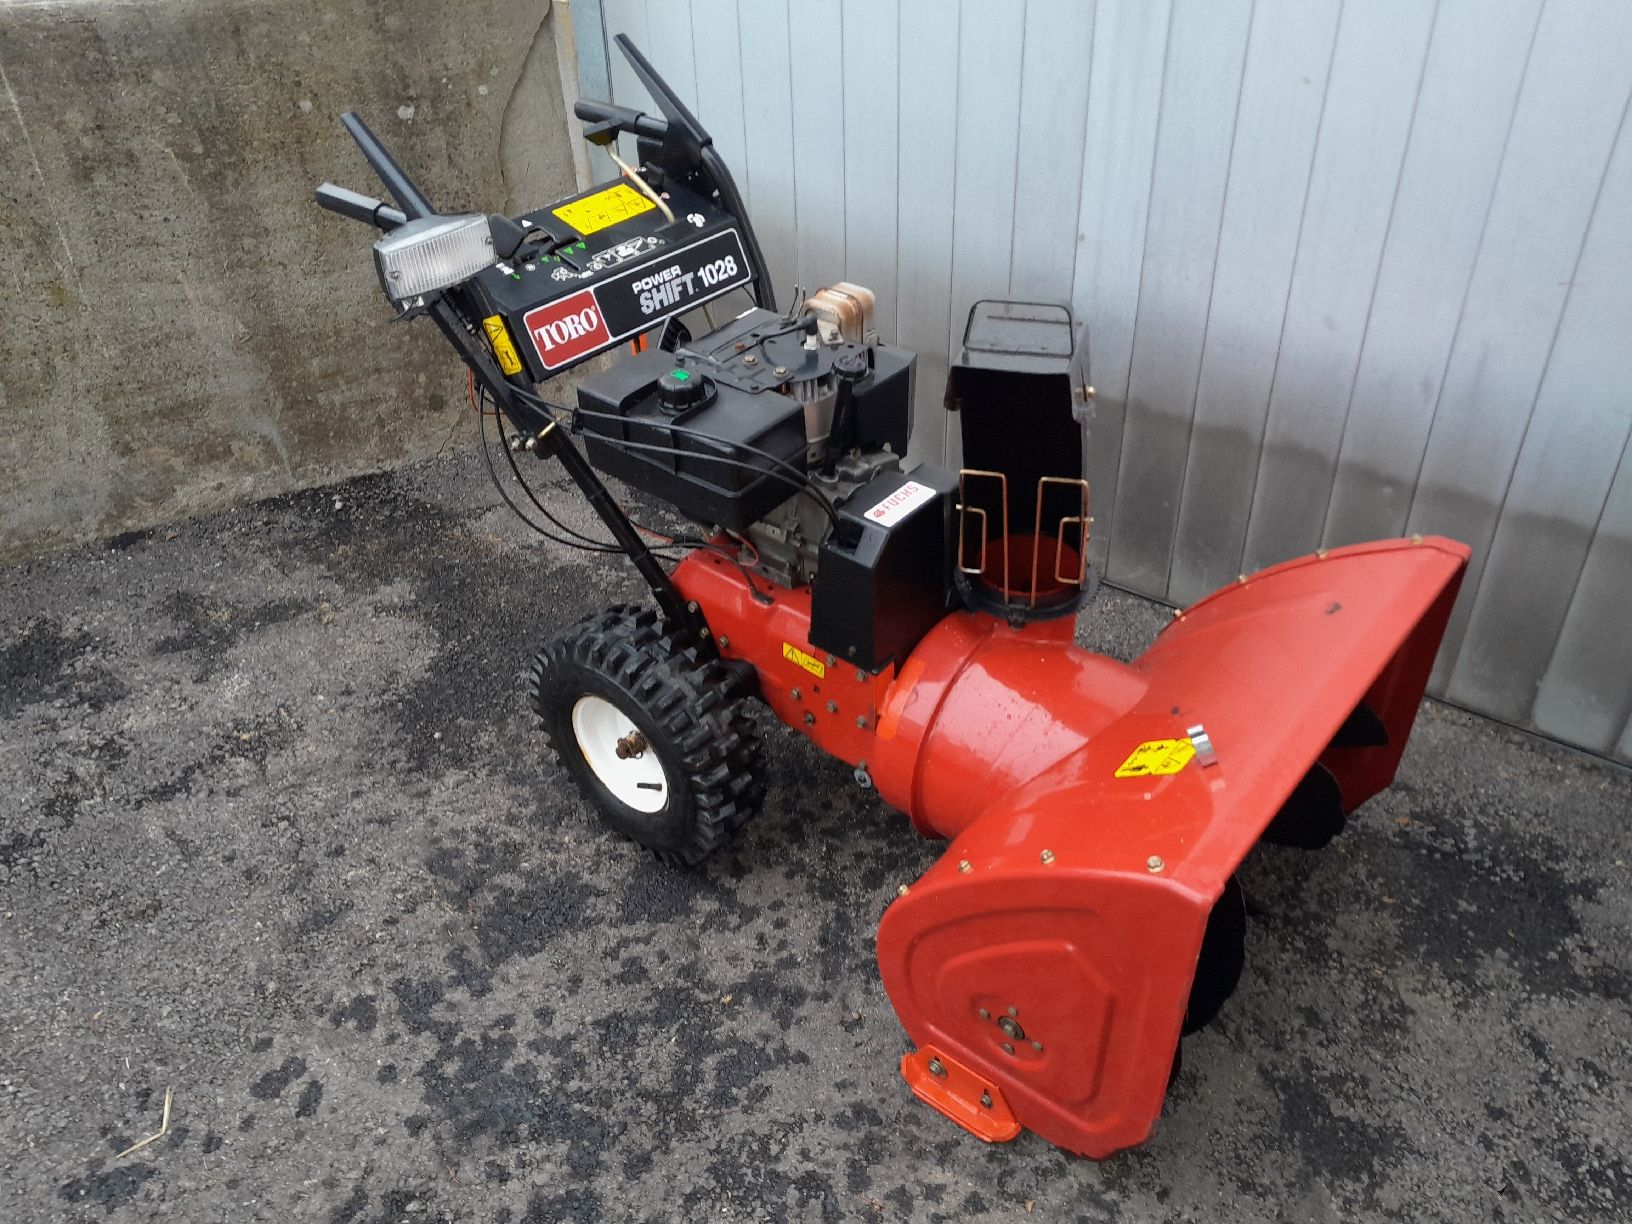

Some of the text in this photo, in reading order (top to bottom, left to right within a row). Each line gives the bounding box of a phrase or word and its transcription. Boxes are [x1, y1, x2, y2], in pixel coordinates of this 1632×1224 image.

[632, 264, 682, 295] POWER
[640, 255, 738, 315] SHIFT 1028
[533, 307, 598, 352] TORO
[882, 484, 919, 511] FUCHS
